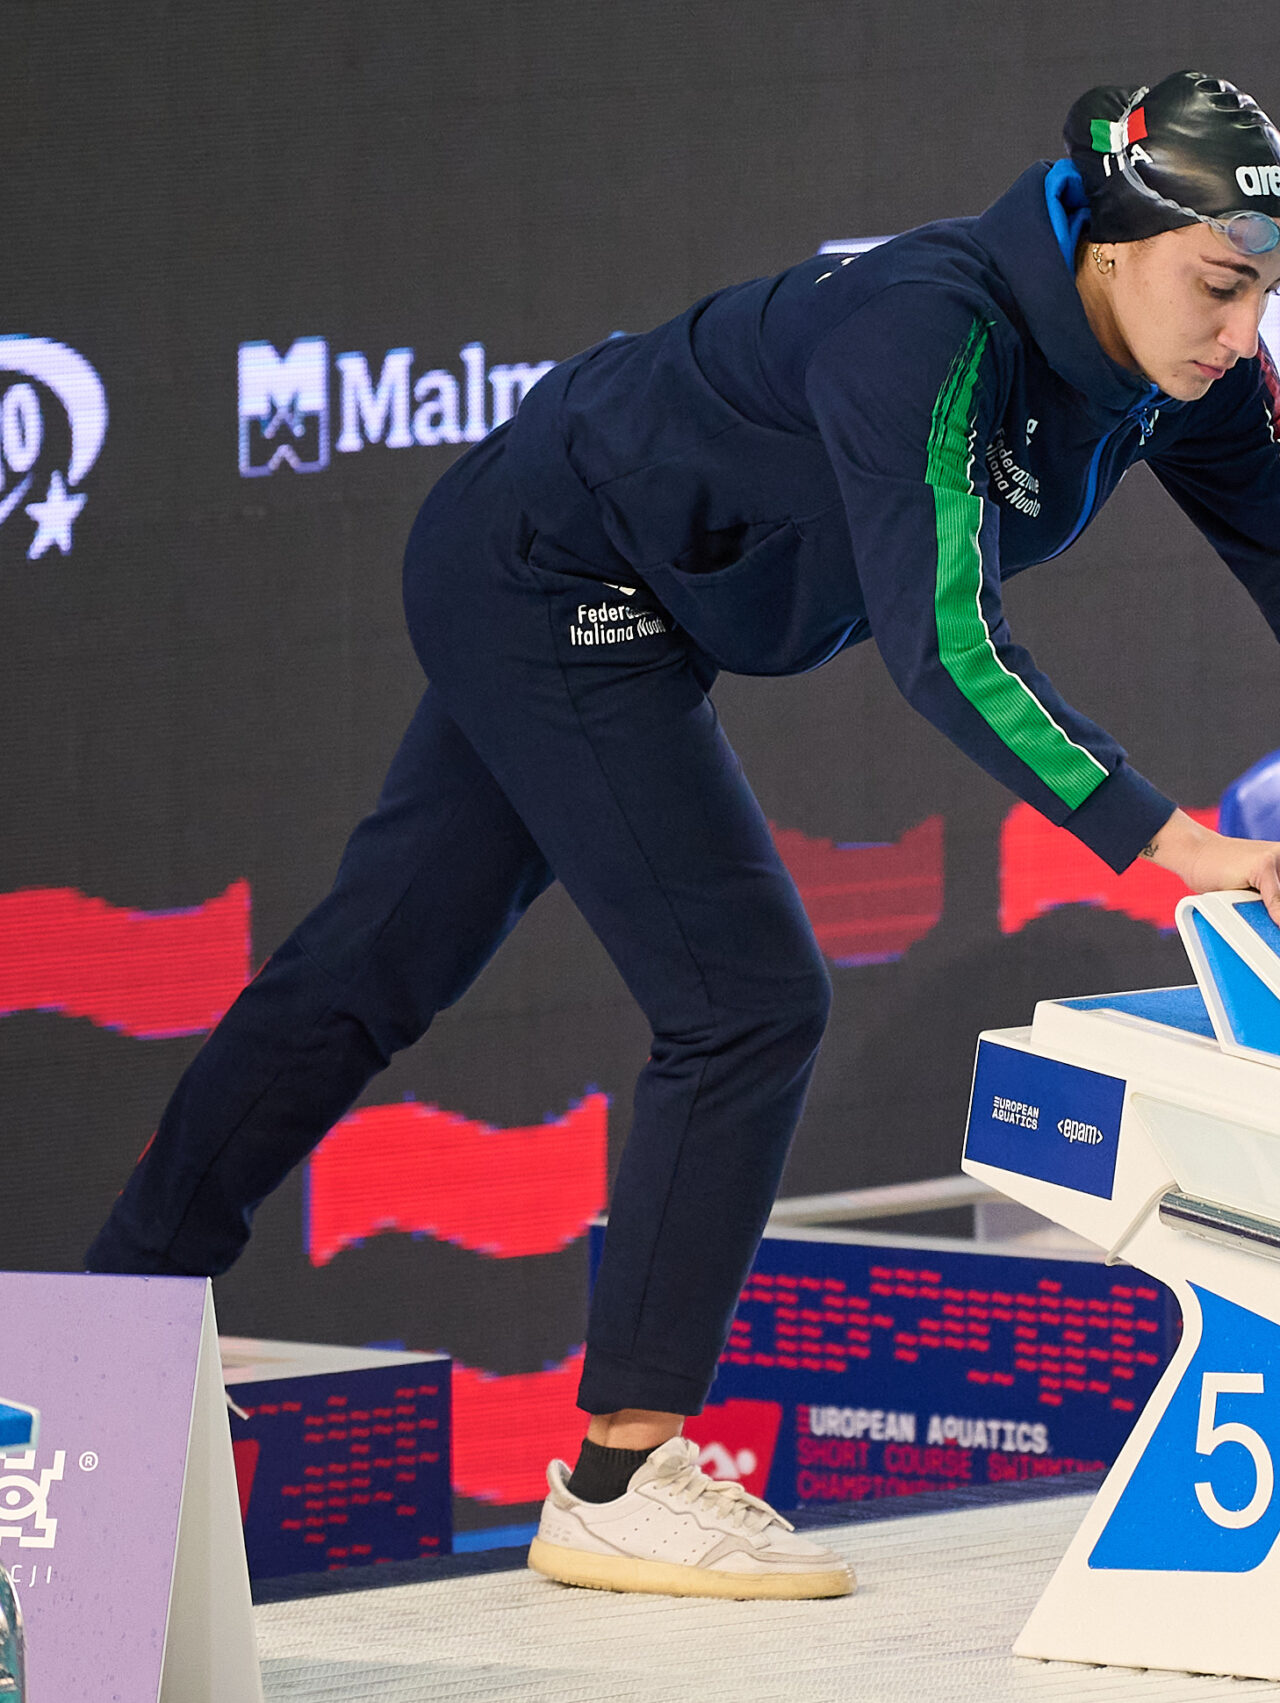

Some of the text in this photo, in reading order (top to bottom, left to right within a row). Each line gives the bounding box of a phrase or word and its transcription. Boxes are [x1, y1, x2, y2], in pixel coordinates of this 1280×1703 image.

[570, 622, 634, 646] Italiana
[991, 1107, 1038, 1131] AQUATICS
[993, 1095, 1040, 1119] EUROPEAN
[927, 1414, 1049, 1455] AQUATICS
[1194, 1371, 1275, 1530] 5
